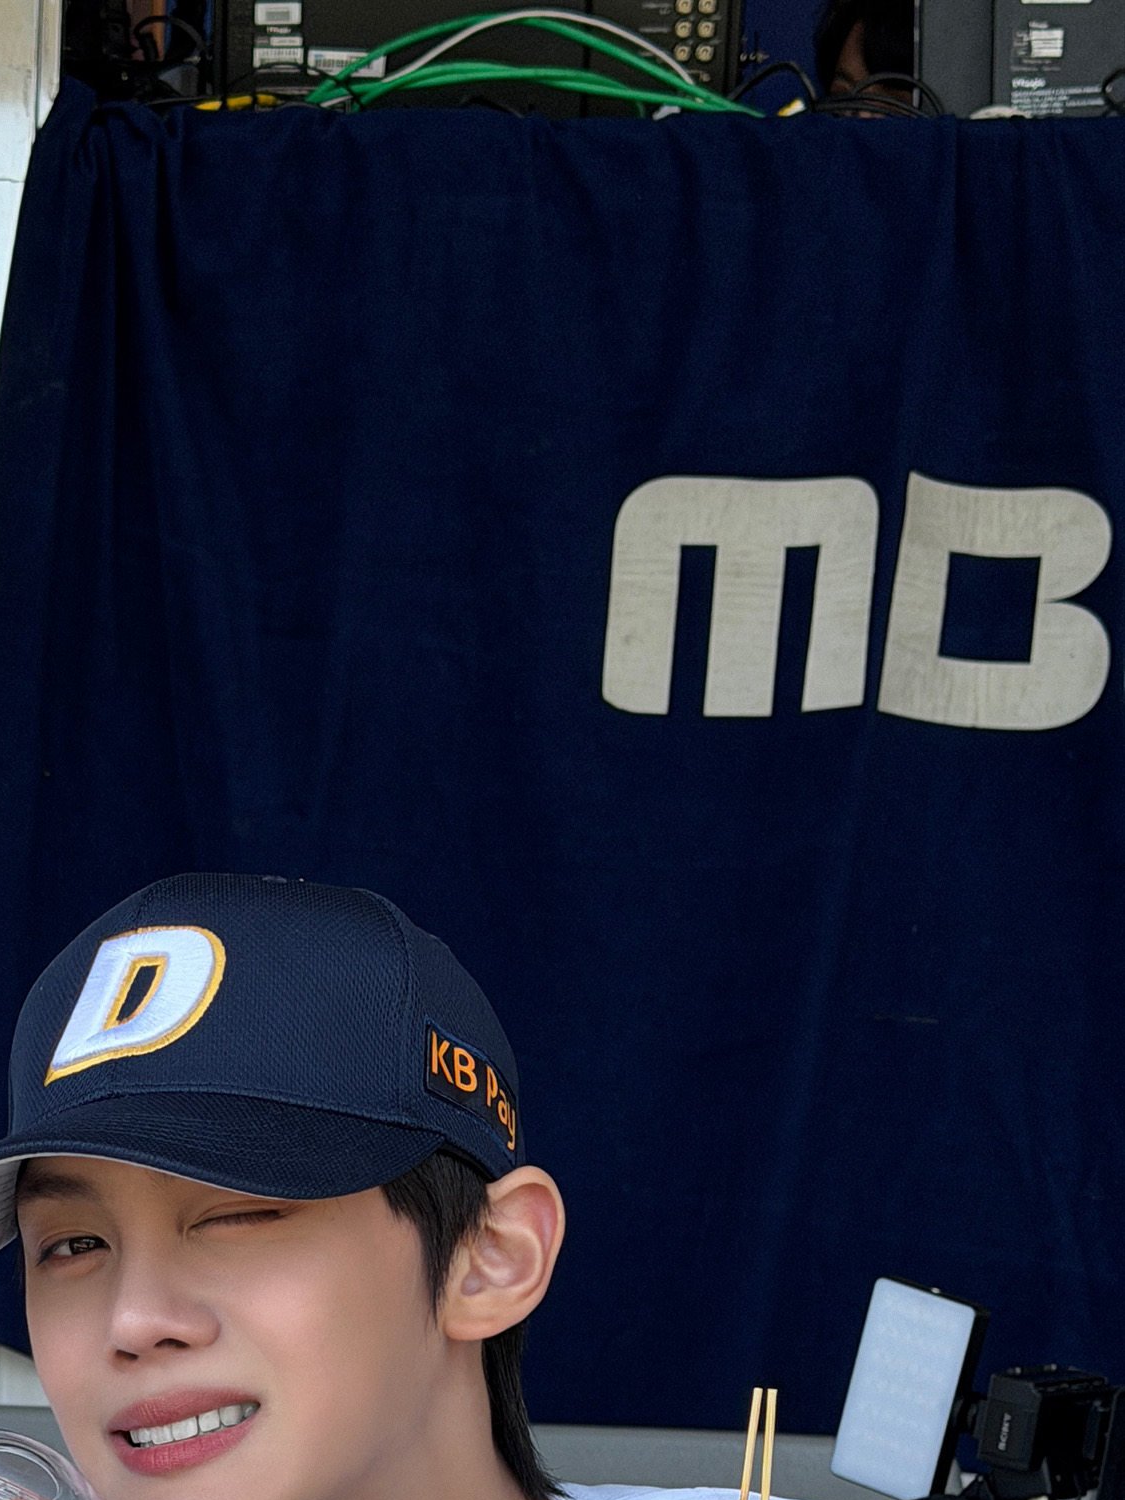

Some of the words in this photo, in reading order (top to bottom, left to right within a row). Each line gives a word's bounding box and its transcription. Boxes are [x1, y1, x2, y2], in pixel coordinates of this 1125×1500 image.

[44, 925, 226, 1087] D
[430, 1030, 478, 1093] KB
[486, 1064, 517, 1151] Pay
